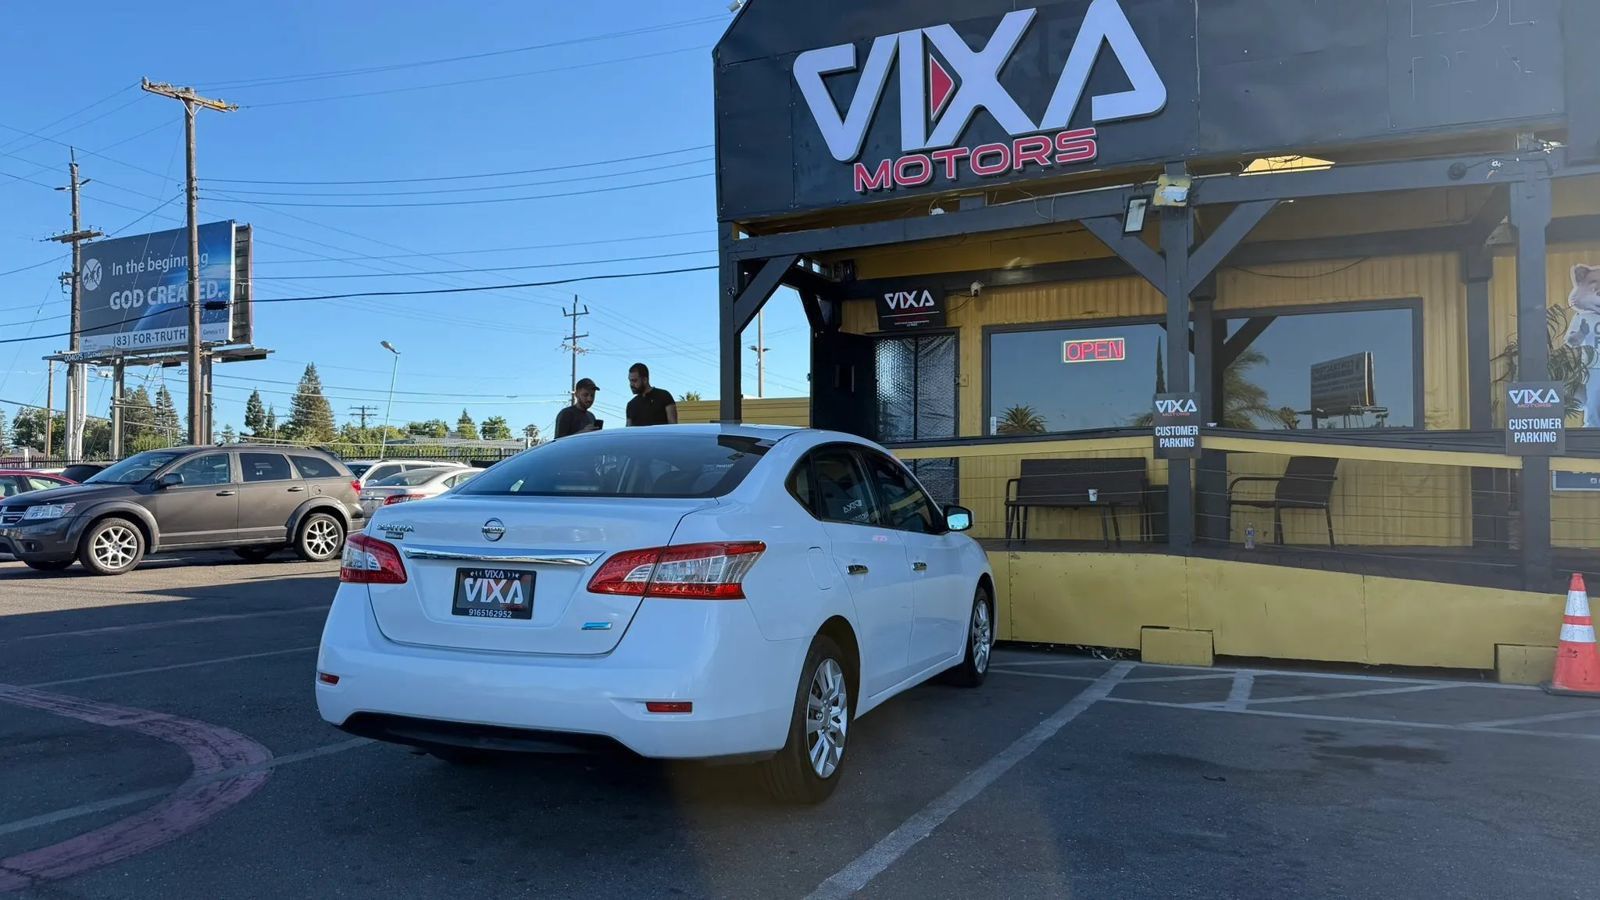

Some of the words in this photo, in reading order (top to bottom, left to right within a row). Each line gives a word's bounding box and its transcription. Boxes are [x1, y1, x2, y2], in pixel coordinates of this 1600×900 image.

[793, 0, 1167, 162] VIXA
[854, 127, 1098, 194] MOTORS
[112, 263, 122, 276] In
[126, 261, 144, 273] the
[148, 253, 209, 272] beginng
[110, 289, 144, 310] GOD
[147, 281, 222, 305] CREAED.
[884, 290, 935, 309] VIXA
[113, 334, 131, 346] (83)
[133, 329, 187, 344] FOR-TRUTH
[1067, 341, 1123, 360] OPEN
[1509, 388, 1560, 404] VIXA
[1155, 399, 1198, 413] VIXA
[1155, 425, 1199, 436] CUSTOMER
[1509, 418, 1561, 430] CUSTOMER
[1160, 437, 1195, 448] PARKING
[1514, 431, 1557, 443] PARKING
[485, 569, 505, 578] VIXA
[464, 578, 523, 604] VIXA
[468, 609, 512, 618] 9165162952
